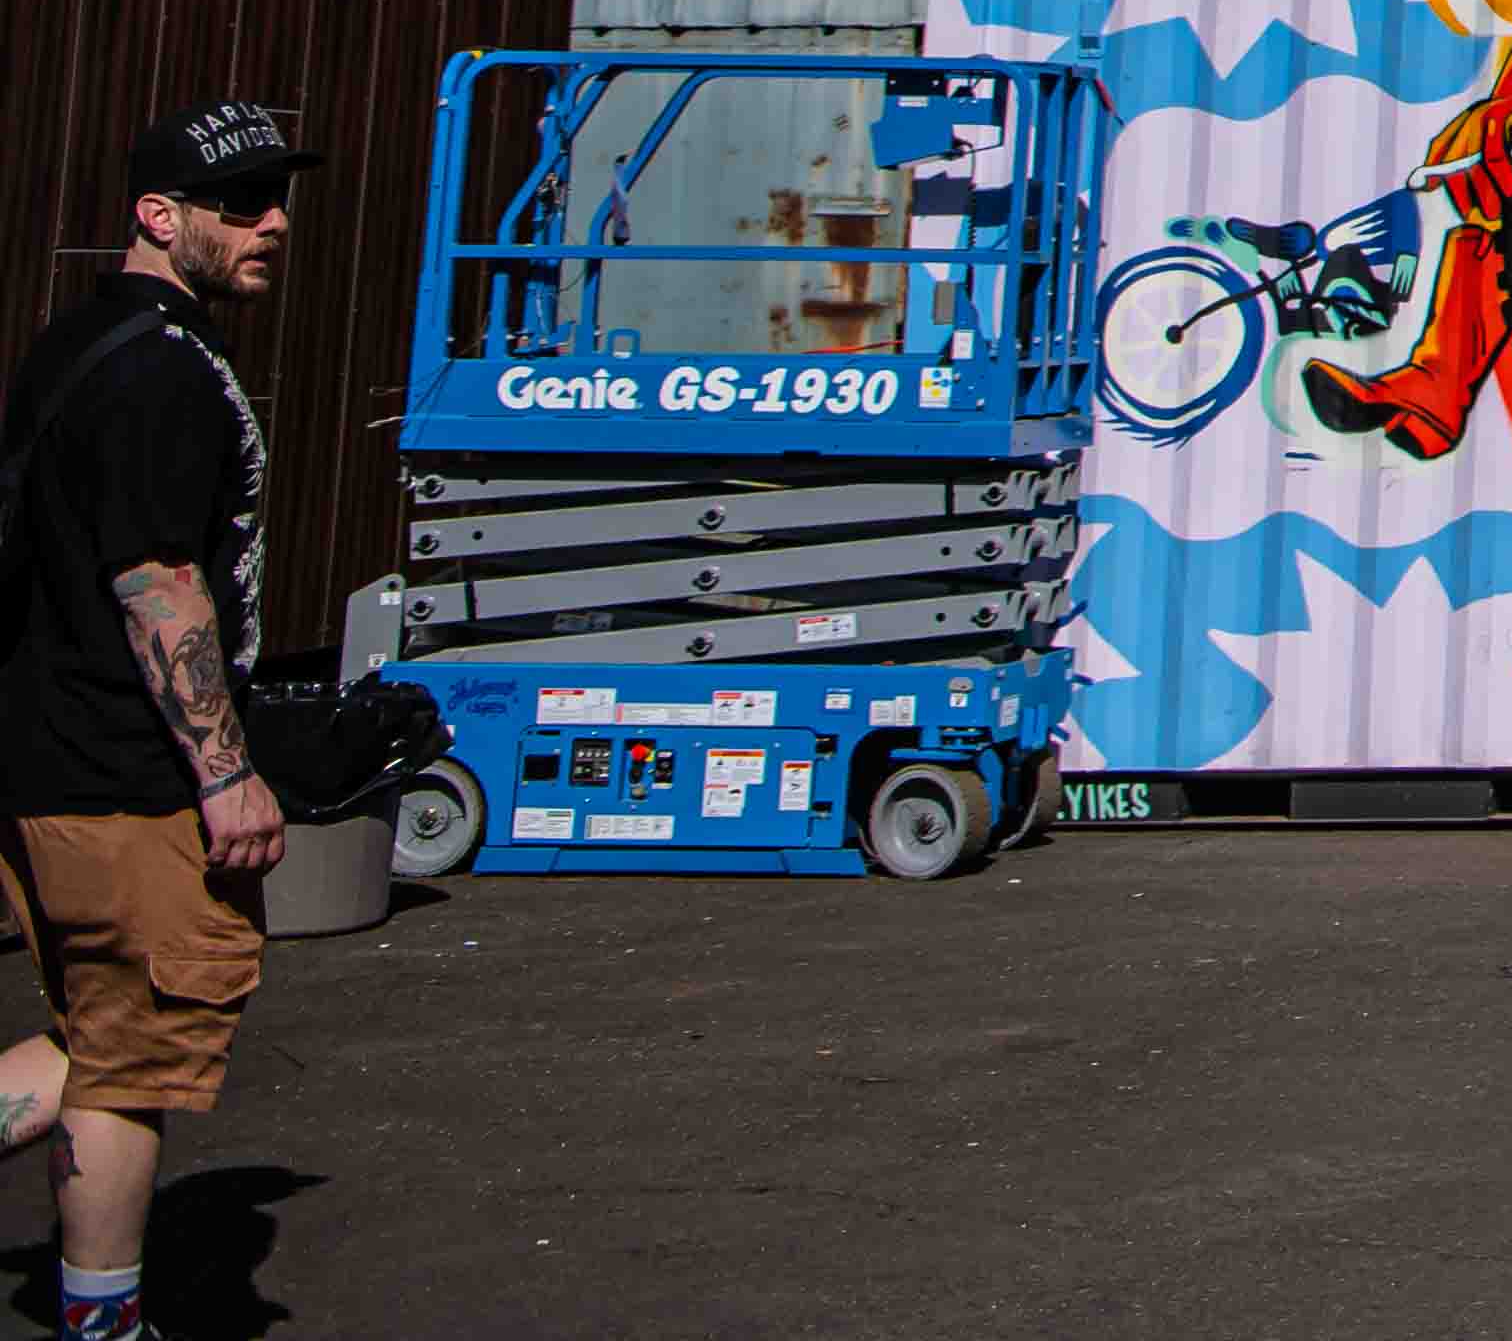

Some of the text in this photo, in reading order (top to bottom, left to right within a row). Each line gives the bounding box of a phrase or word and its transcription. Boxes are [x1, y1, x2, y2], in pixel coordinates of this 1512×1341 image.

[185, 101, 274, 143] HARL
[497, 365, 898, 415] Genie GS-1930
